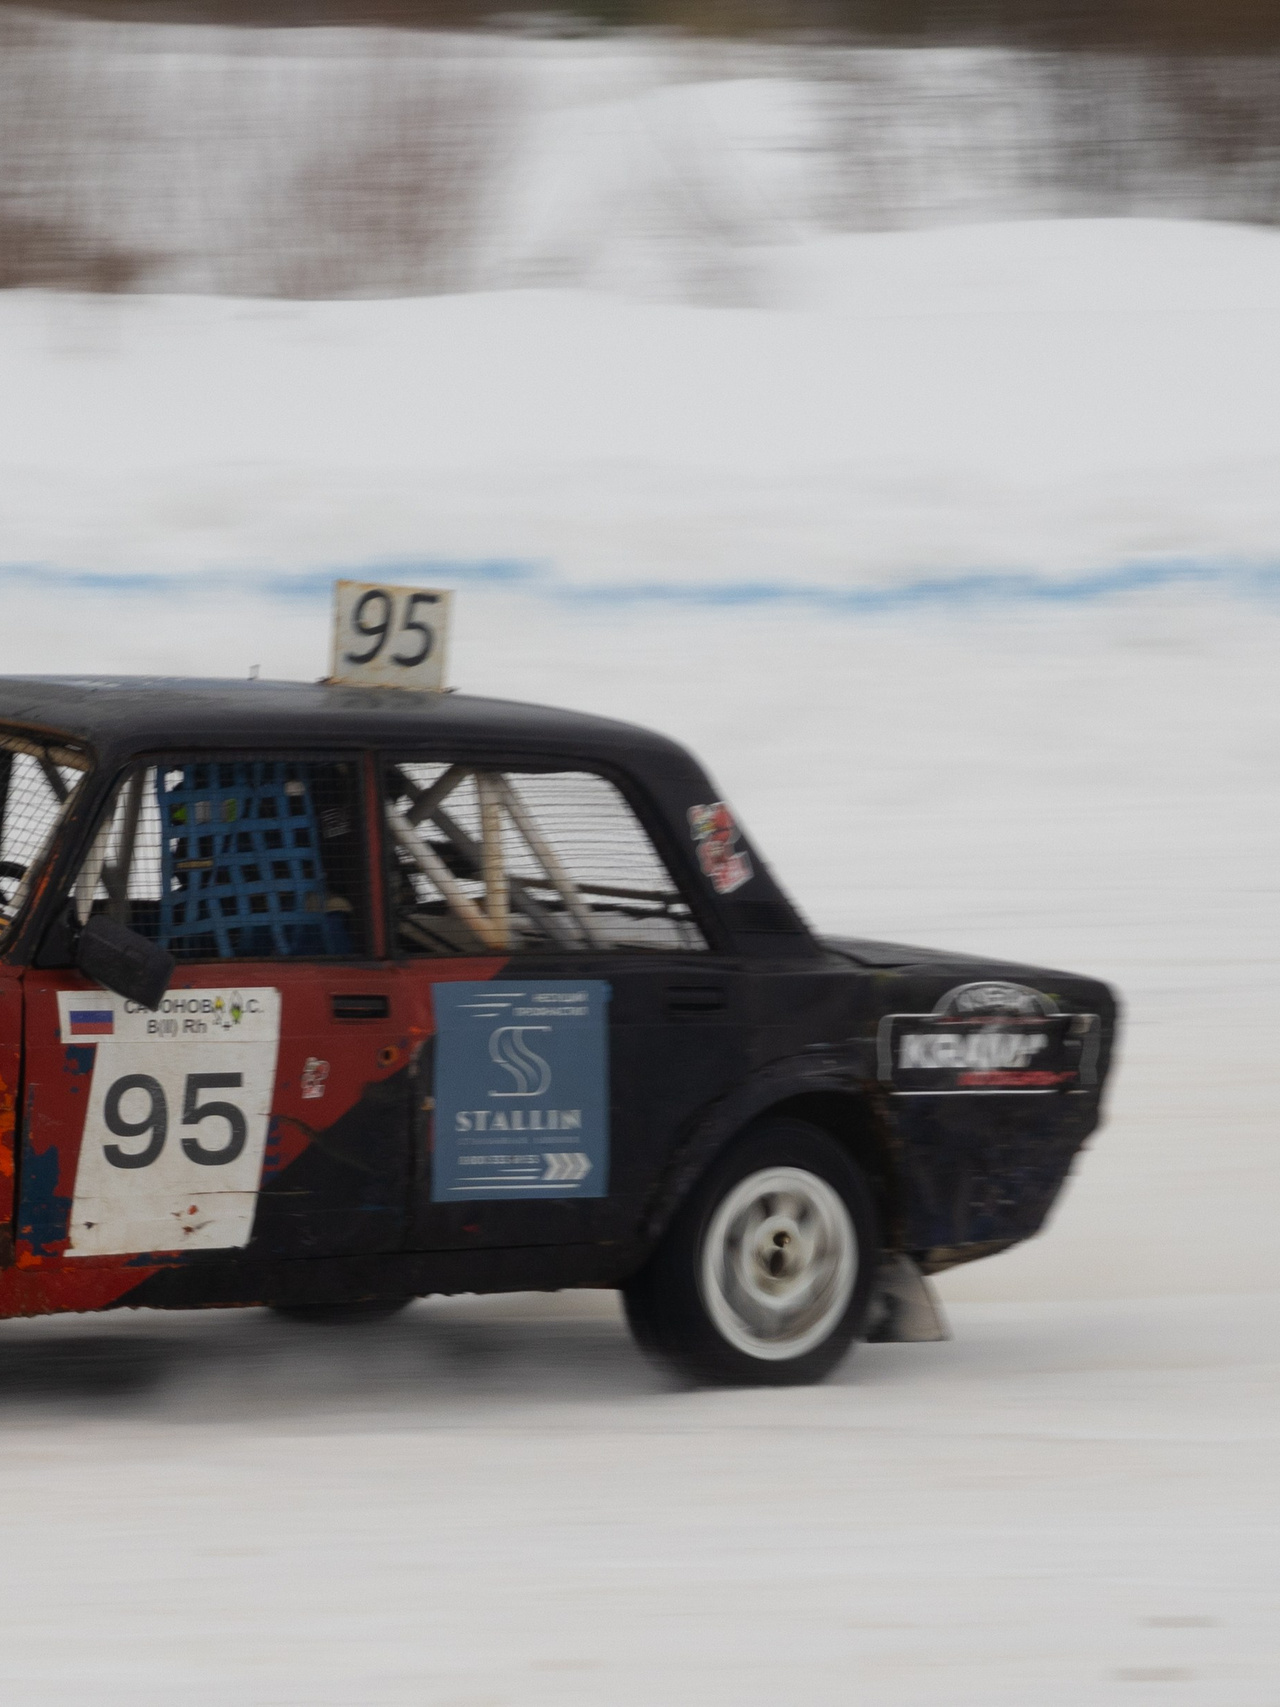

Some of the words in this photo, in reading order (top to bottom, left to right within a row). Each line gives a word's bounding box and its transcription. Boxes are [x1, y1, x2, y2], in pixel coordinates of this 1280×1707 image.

[345, 588, 441, 667] 95
[102, 1072, 248, 1169] 95
[455, 1110, 582, 1131] STALLIN
